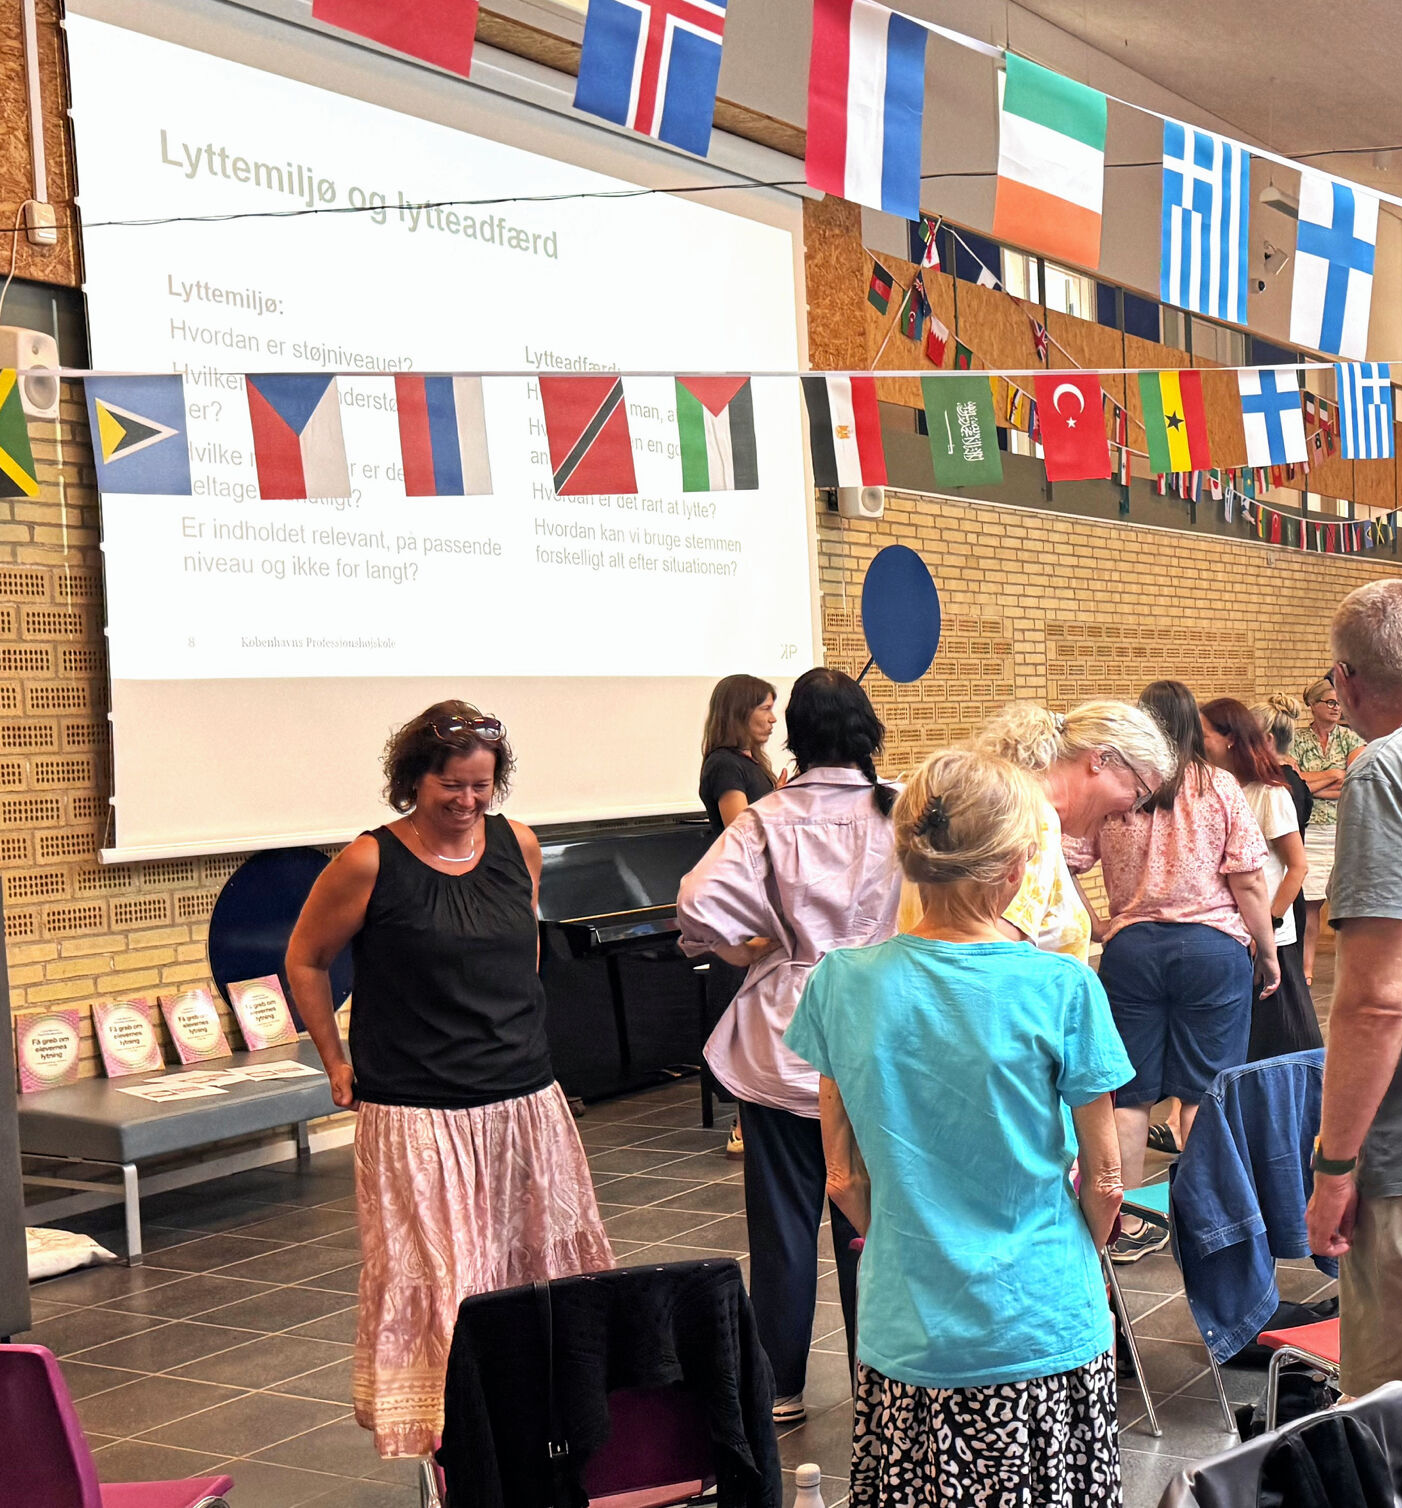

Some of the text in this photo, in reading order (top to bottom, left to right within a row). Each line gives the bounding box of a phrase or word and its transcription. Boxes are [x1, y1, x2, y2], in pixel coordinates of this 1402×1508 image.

[160, 128, 559, 259] Lyttemiljø og lytteadfærd
[167, 274, 284, 316] Lyttemiljø:
[169, 318, 413, 373] Hvordan er støjniveauet?
[190, 441, 243, 467] vilke
[362, 463, 380, 480] er
[641, 498, 663, 514] rart
[667, 500, 679, 515] at
[683, 500, 717, 520] lytte?
[181, 516, 502, 557] Er indholdet relevant, på passende
[534, 517, 742, 553] Hvordan kan vi bruge stemmen
[184, 551, 418, 584] niveau og ikke for langt?
[536, 545, 605, 570] forskelligt
[629, 553, 658, 572] efter
[662, 558, 738, 577] situationen?
[240, 636, 304, 649] Københavns
